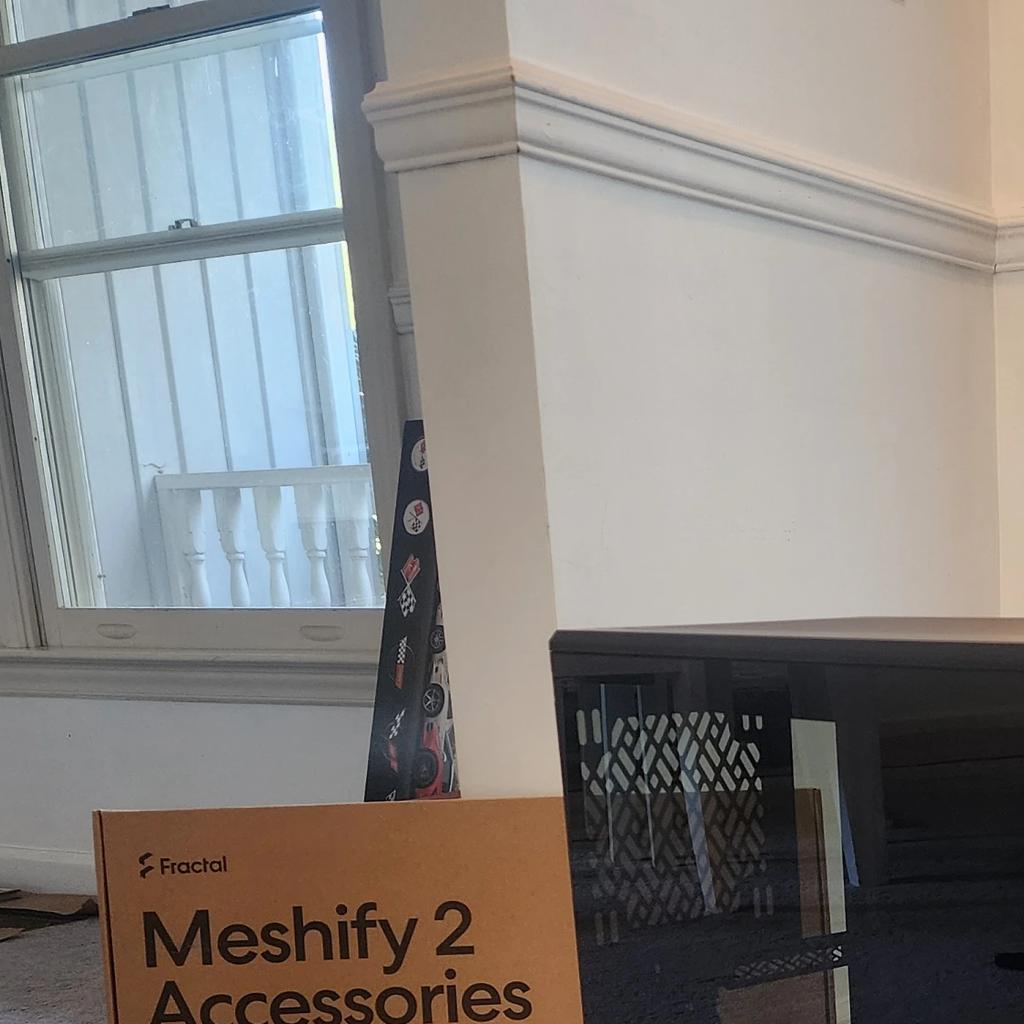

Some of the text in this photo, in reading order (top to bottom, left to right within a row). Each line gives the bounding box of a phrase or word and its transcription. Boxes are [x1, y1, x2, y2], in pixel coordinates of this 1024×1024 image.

[160, 855, 228, 875] Fractal
[142, 900, 475, 975] Meshify 2
